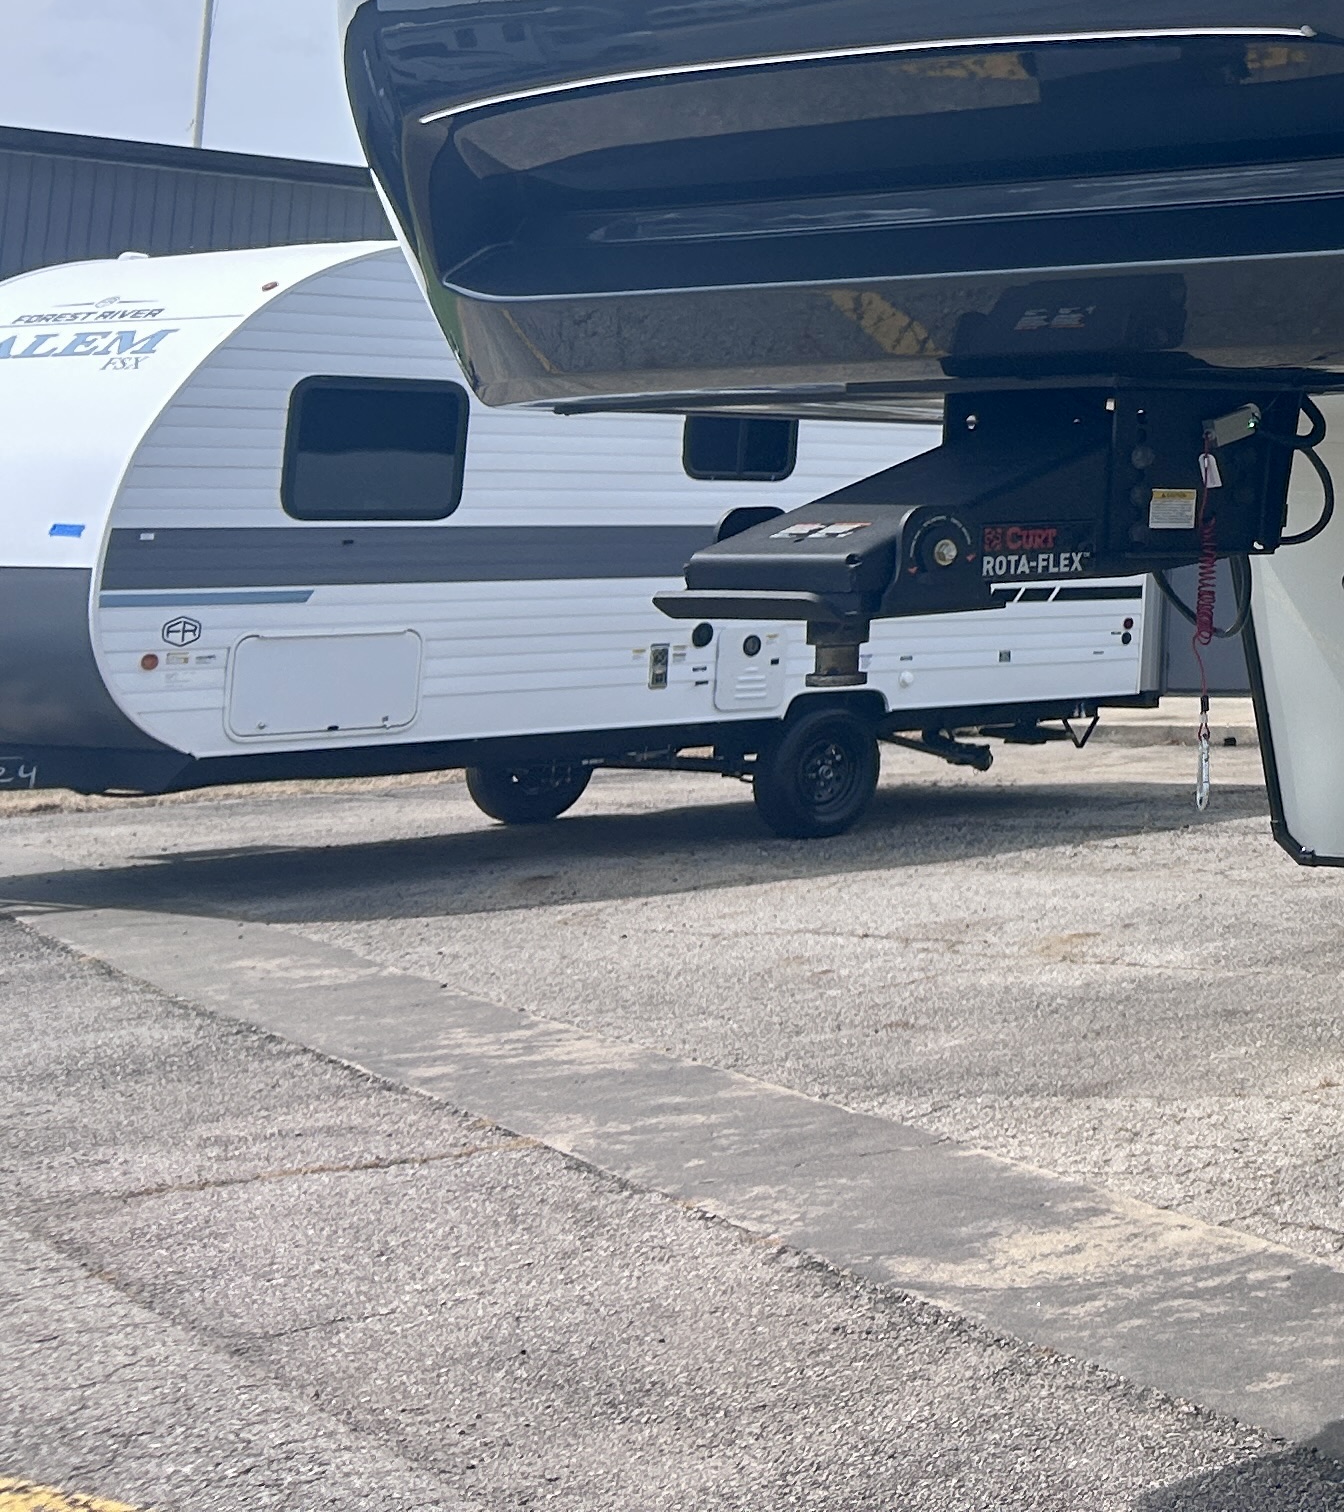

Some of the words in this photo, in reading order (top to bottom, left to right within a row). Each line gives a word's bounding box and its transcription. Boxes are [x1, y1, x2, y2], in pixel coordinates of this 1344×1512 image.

[12, 311, 98, 324] FOREST
[95, 308, 165, 320] RIVER
[100, 356, 149, 370] FSX
[1006, 526, 1057, 550] CURT
